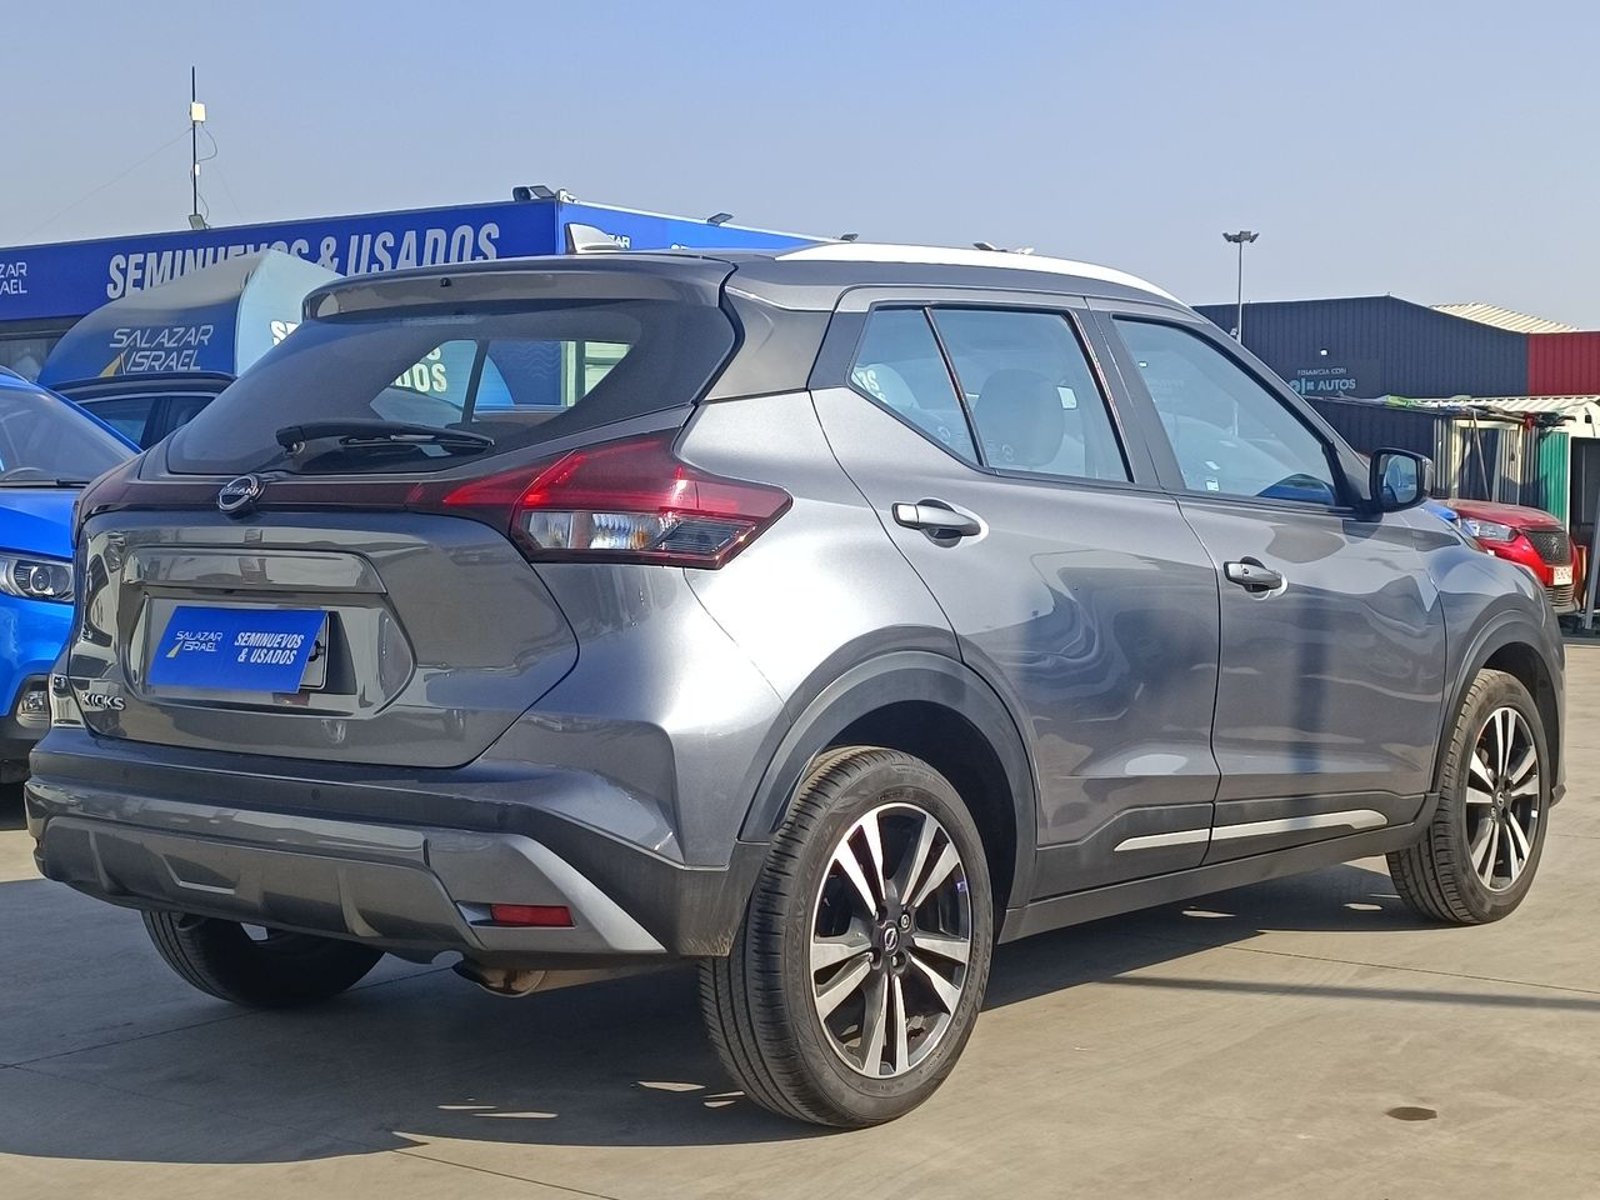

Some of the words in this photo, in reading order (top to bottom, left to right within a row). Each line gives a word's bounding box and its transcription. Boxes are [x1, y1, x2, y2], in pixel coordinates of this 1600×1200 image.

[347, 222, 500, 277] USADOS
[109, 324, 214, 349] SALAZAR
[126, 348, 201, 372] ISRAEL
[1317, 378, 1356, 391] AUTOS
[175, 631, 224, 643] SALAZAR
[234, 632, 304, 649] SEMINUEVOS
[183, 641, 218, 653] ISRAEL
[237, 648, 248, 663] &
[250, 650, 297, 665] USADOS
[82, 693, 126, 711] KICKS
